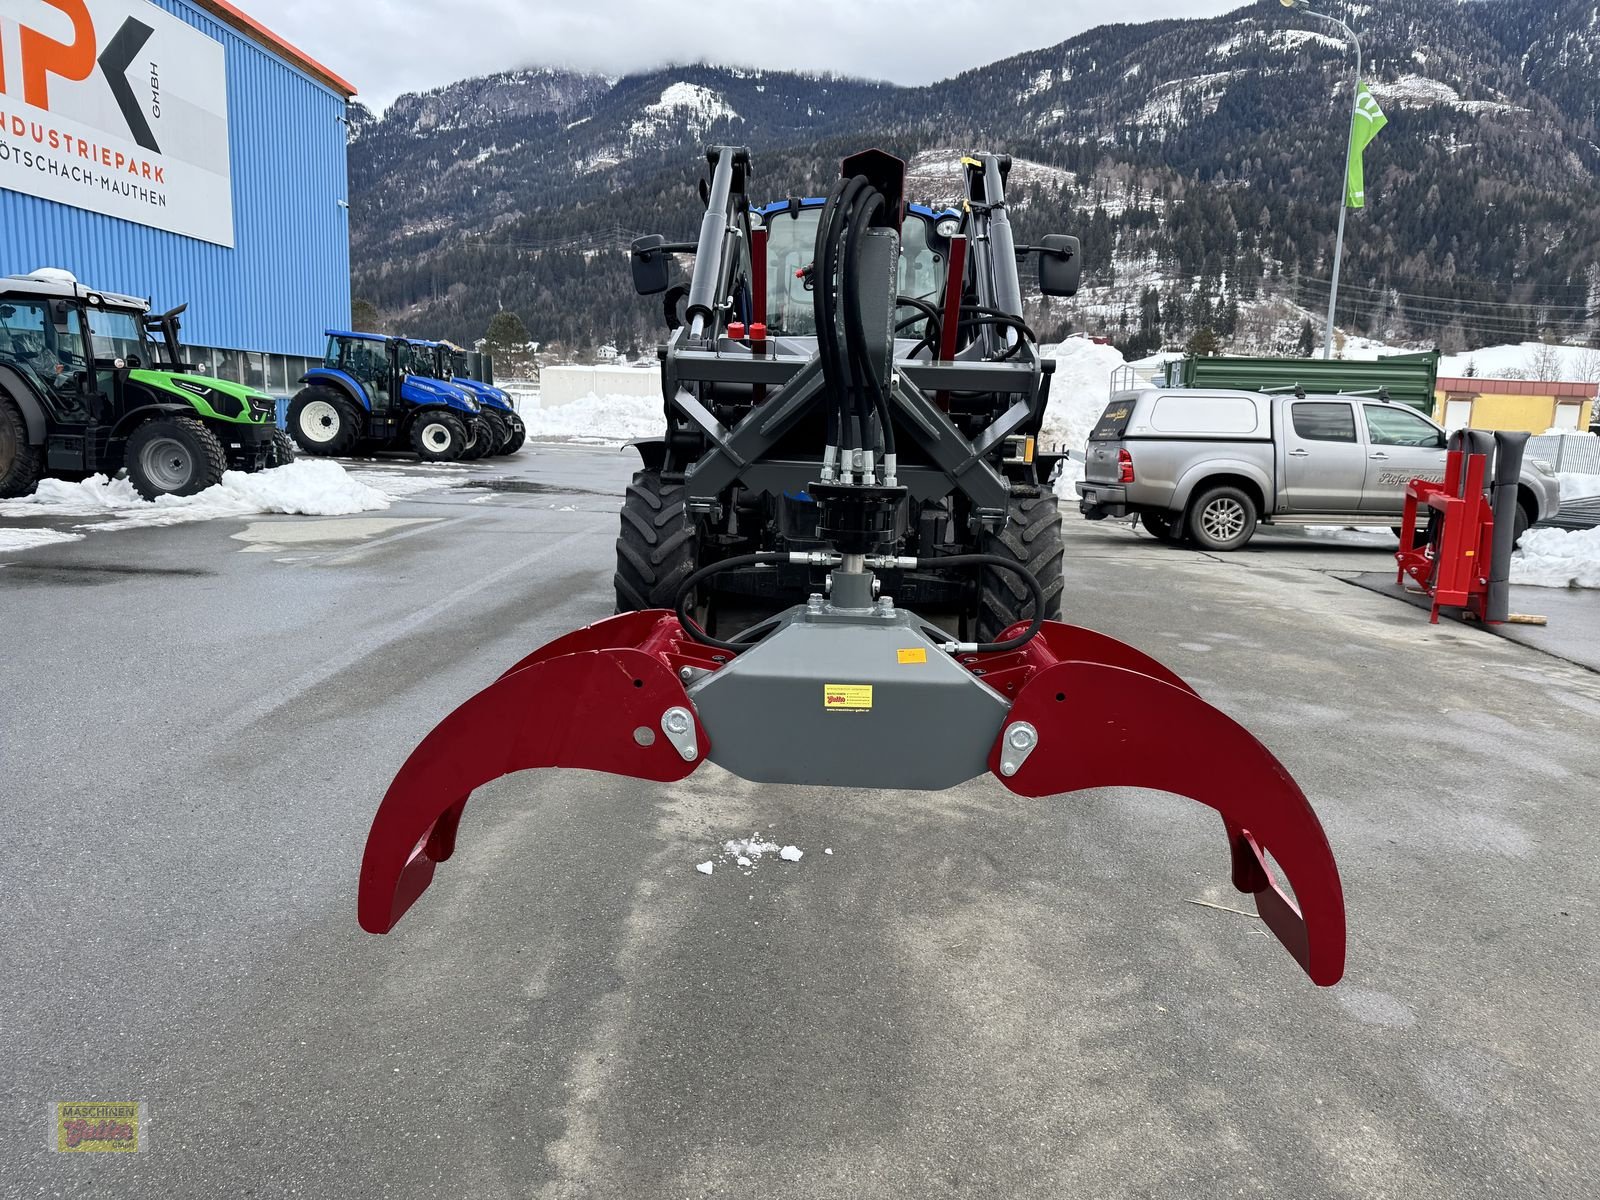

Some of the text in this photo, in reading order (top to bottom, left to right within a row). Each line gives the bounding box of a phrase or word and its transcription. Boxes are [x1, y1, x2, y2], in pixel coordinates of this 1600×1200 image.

[0, 0, 162, 155] PK
[150, 62, 161, 119] GMBH
[0, 140, 167, 207] ÖTSCHACH-MAUTHEN
